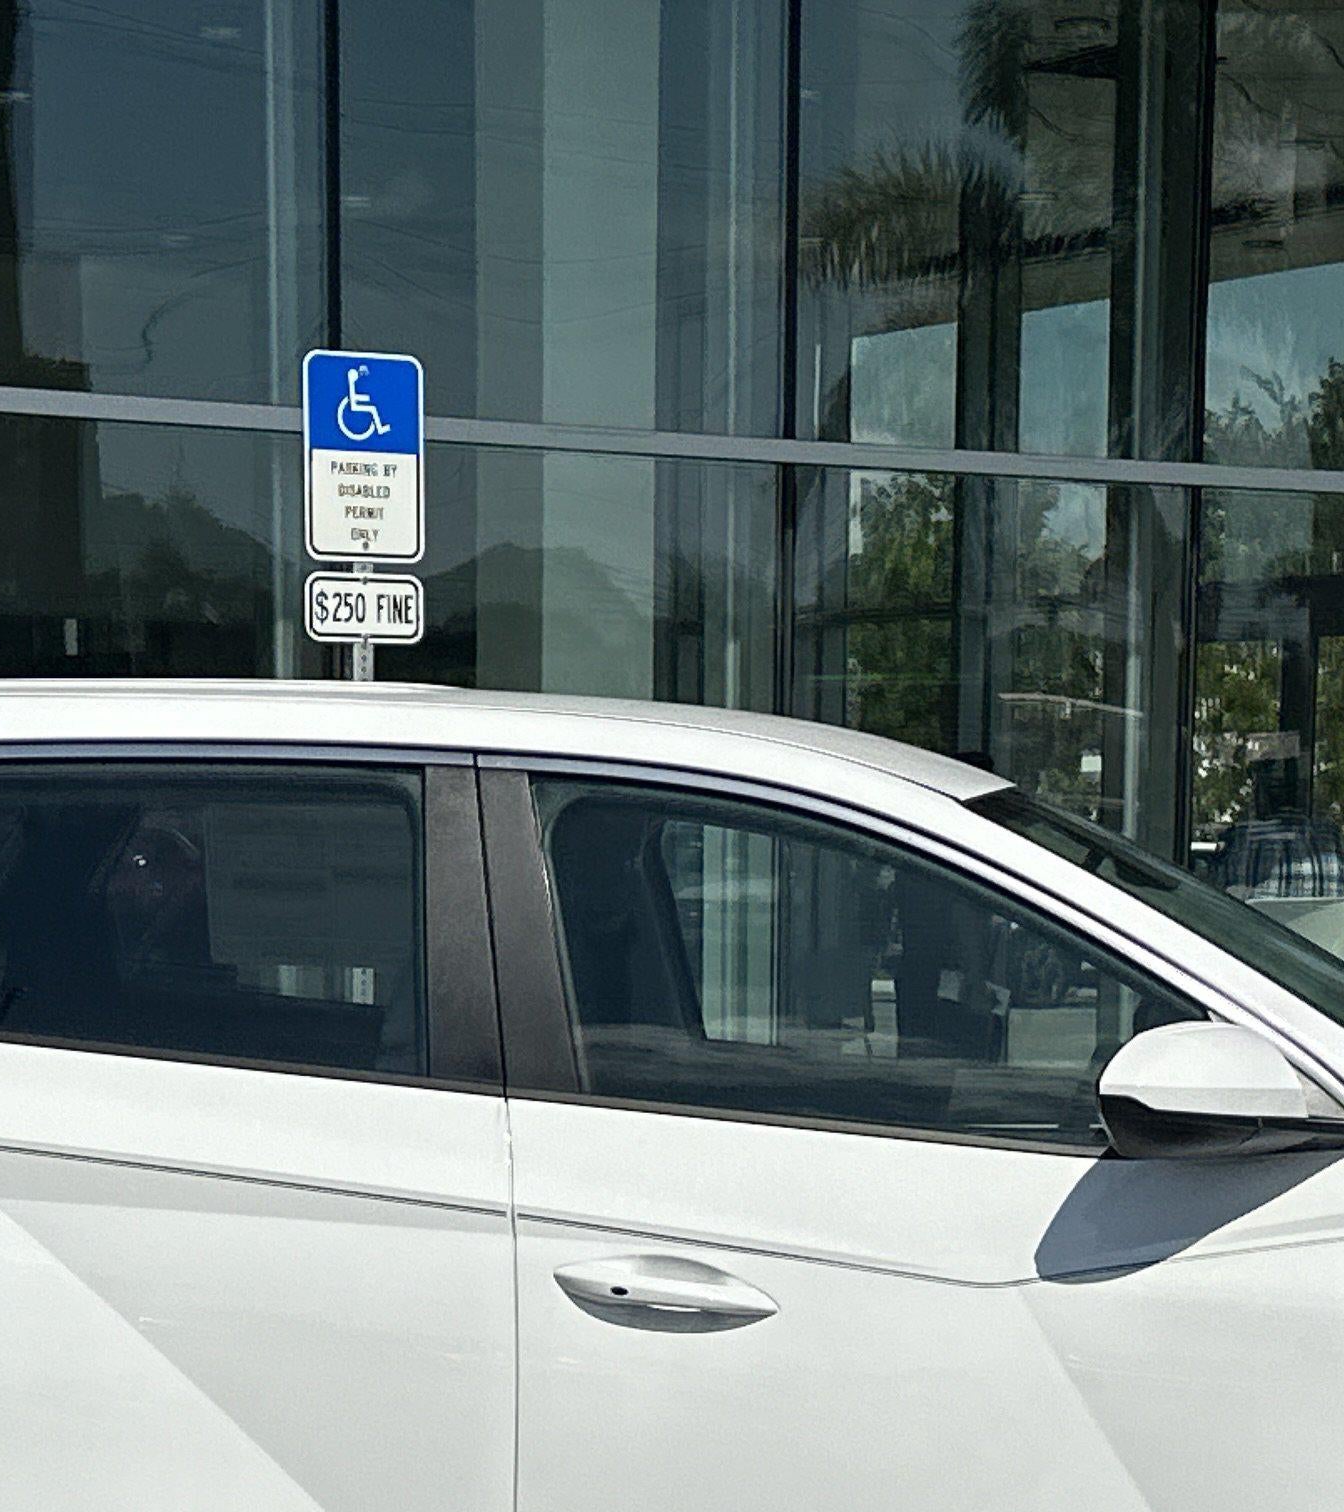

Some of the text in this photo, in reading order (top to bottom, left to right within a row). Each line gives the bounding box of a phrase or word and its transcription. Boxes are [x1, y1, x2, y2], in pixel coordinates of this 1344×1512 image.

[331, 461, 397, 477] PARKING BY
[338, 483, 391, 498] DISABLED
[344, 505, 384, 520] PERMIT
[350, 527, 379, 542] ONLY
[315, 588, 414, 626] $250 FINE
